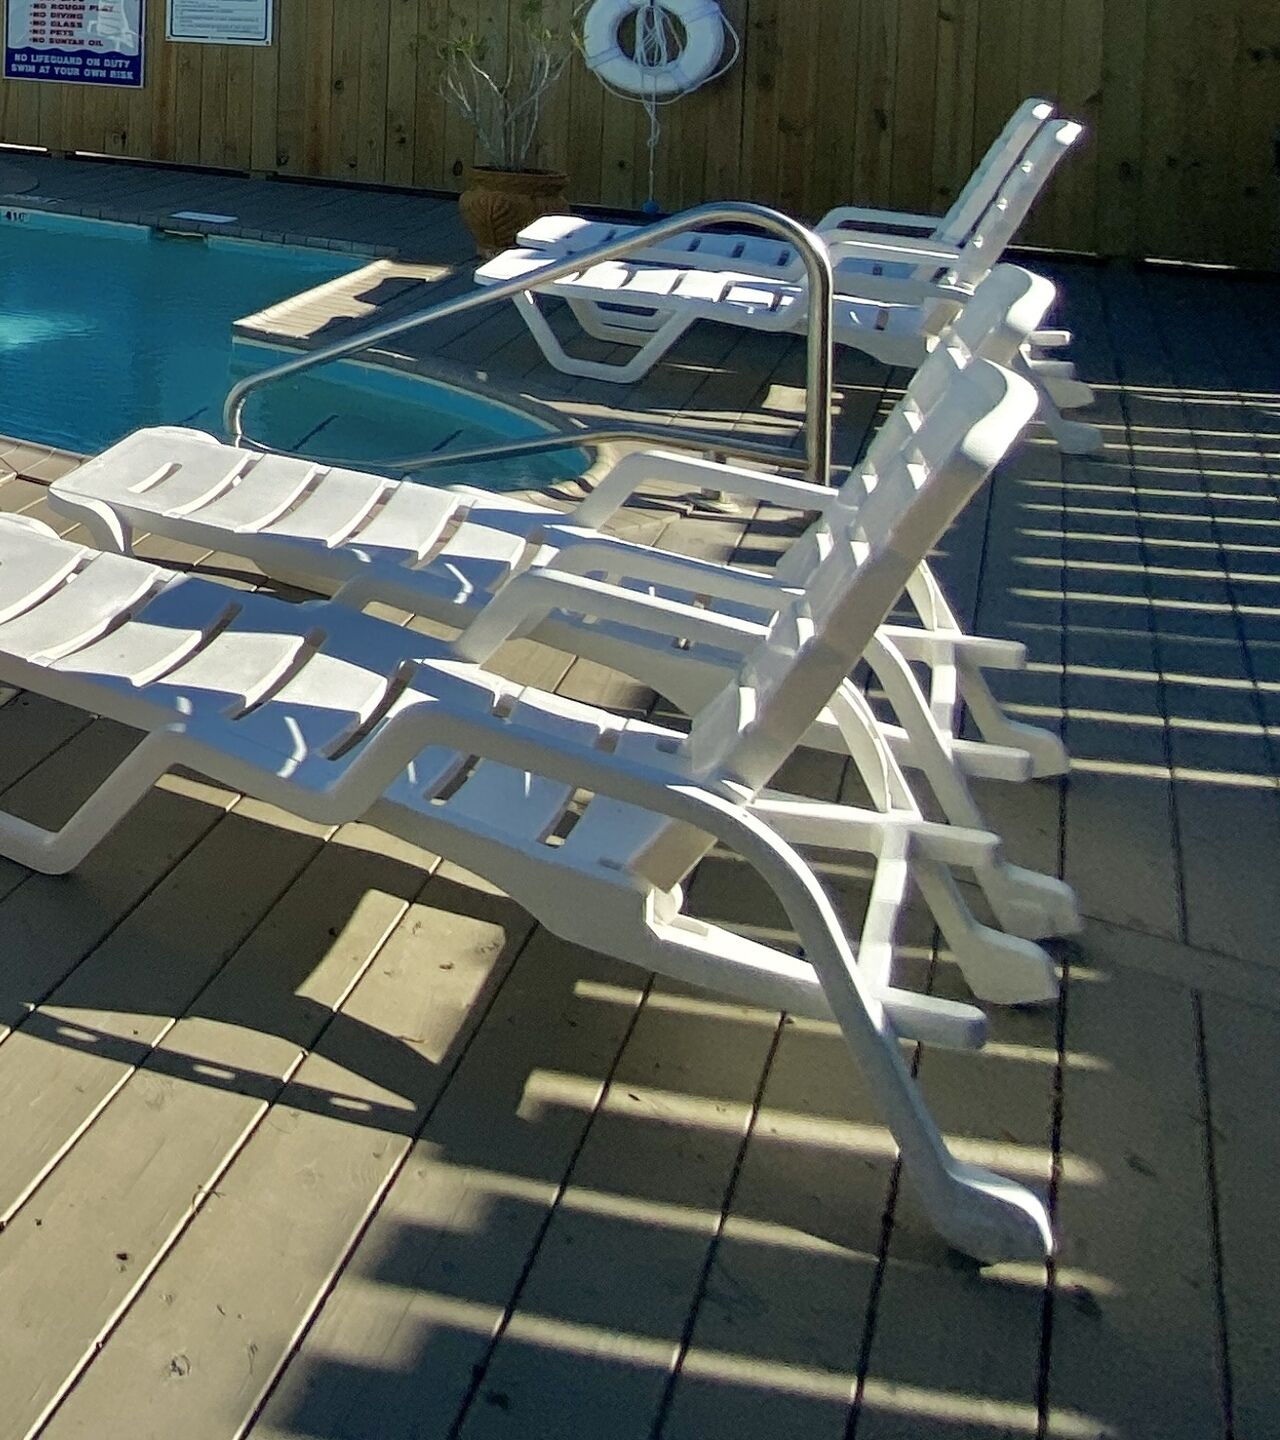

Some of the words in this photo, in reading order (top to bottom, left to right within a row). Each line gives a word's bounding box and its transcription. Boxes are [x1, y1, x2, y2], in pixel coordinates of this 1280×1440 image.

[14, 53, 28, 62] NO
[31, 54, 83, 66] LIFEGUARD
[86, 58, 101, 67] ON
[104, 59, 131, 68] DUTY
[11, 63, 36, 73] SWIM
[38, 65, 50, 74] AT
[54, 66, 80, 76] YOUR
[83, 69, 107, 77] OWN
[110, 69, 134, 80] RISK
